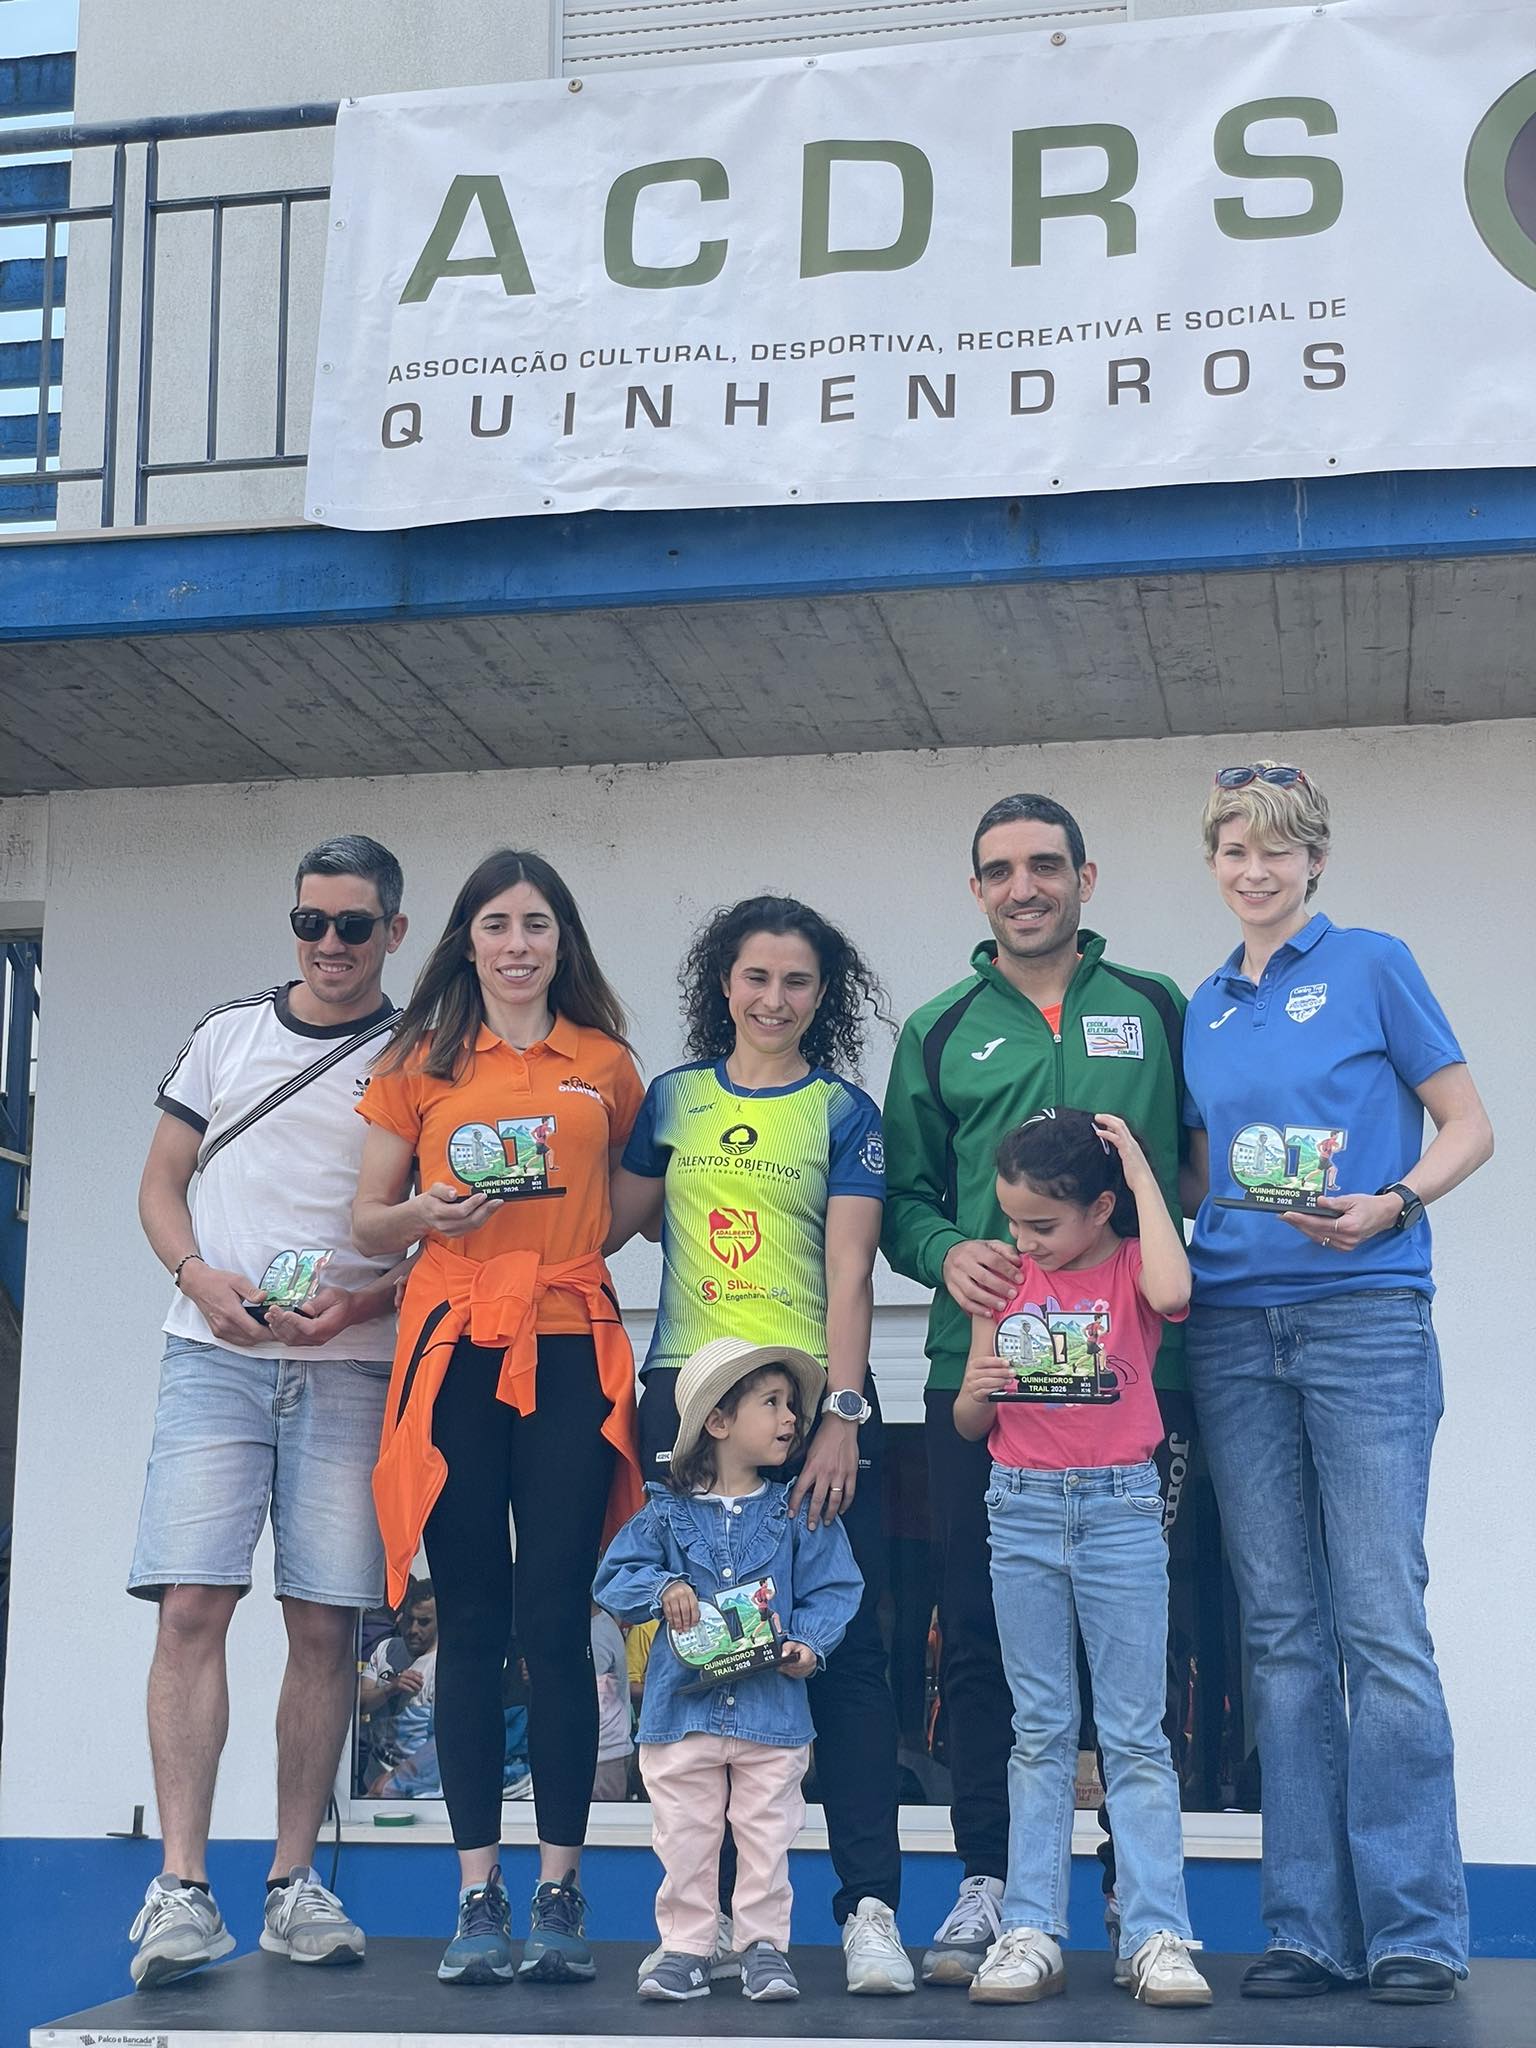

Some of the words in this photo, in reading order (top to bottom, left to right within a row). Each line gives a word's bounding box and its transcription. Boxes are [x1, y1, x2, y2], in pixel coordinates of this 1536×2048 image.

[388, 349, 568, 384] ASSOCIAÇÃO
[580, 344, 737, 368] CULTURAL,
[751, 333, 944, 361] DESPORTIVA,
[958, 316, 1143, 351] RECREATIVA
[1157, 313, 1171, 332] E
[1185, 302, 1295, 330] SOCIAL
[1308, 298, 1347, 320] DE
[381, 342, 1346, 449] QUINHENDROS
[677, 1155, 730, 1168] TALENTOS
[734, 1157, 801, 1180] OBJETIVOS
[474, 1178, 525, 1188] QUINHENDROS
[1249, 1187, 1300, 1197] QUINHENDROS
[1256, 1195, 1275, 1204] TRAIL
[1021, 1376, 1074, 1384] QUINHENDROS
[1029, 1385, 1049, 1393] TRAIL
[1050, 1385, 1067, 1393] 2026
[704, 1649, 756, 1671] QUINHENDROS
[713, 1667, 734, 1677] TRAIL
[735, 1661, 751, 1672] 2026
[98, 2035, 116, 2043] Palco
